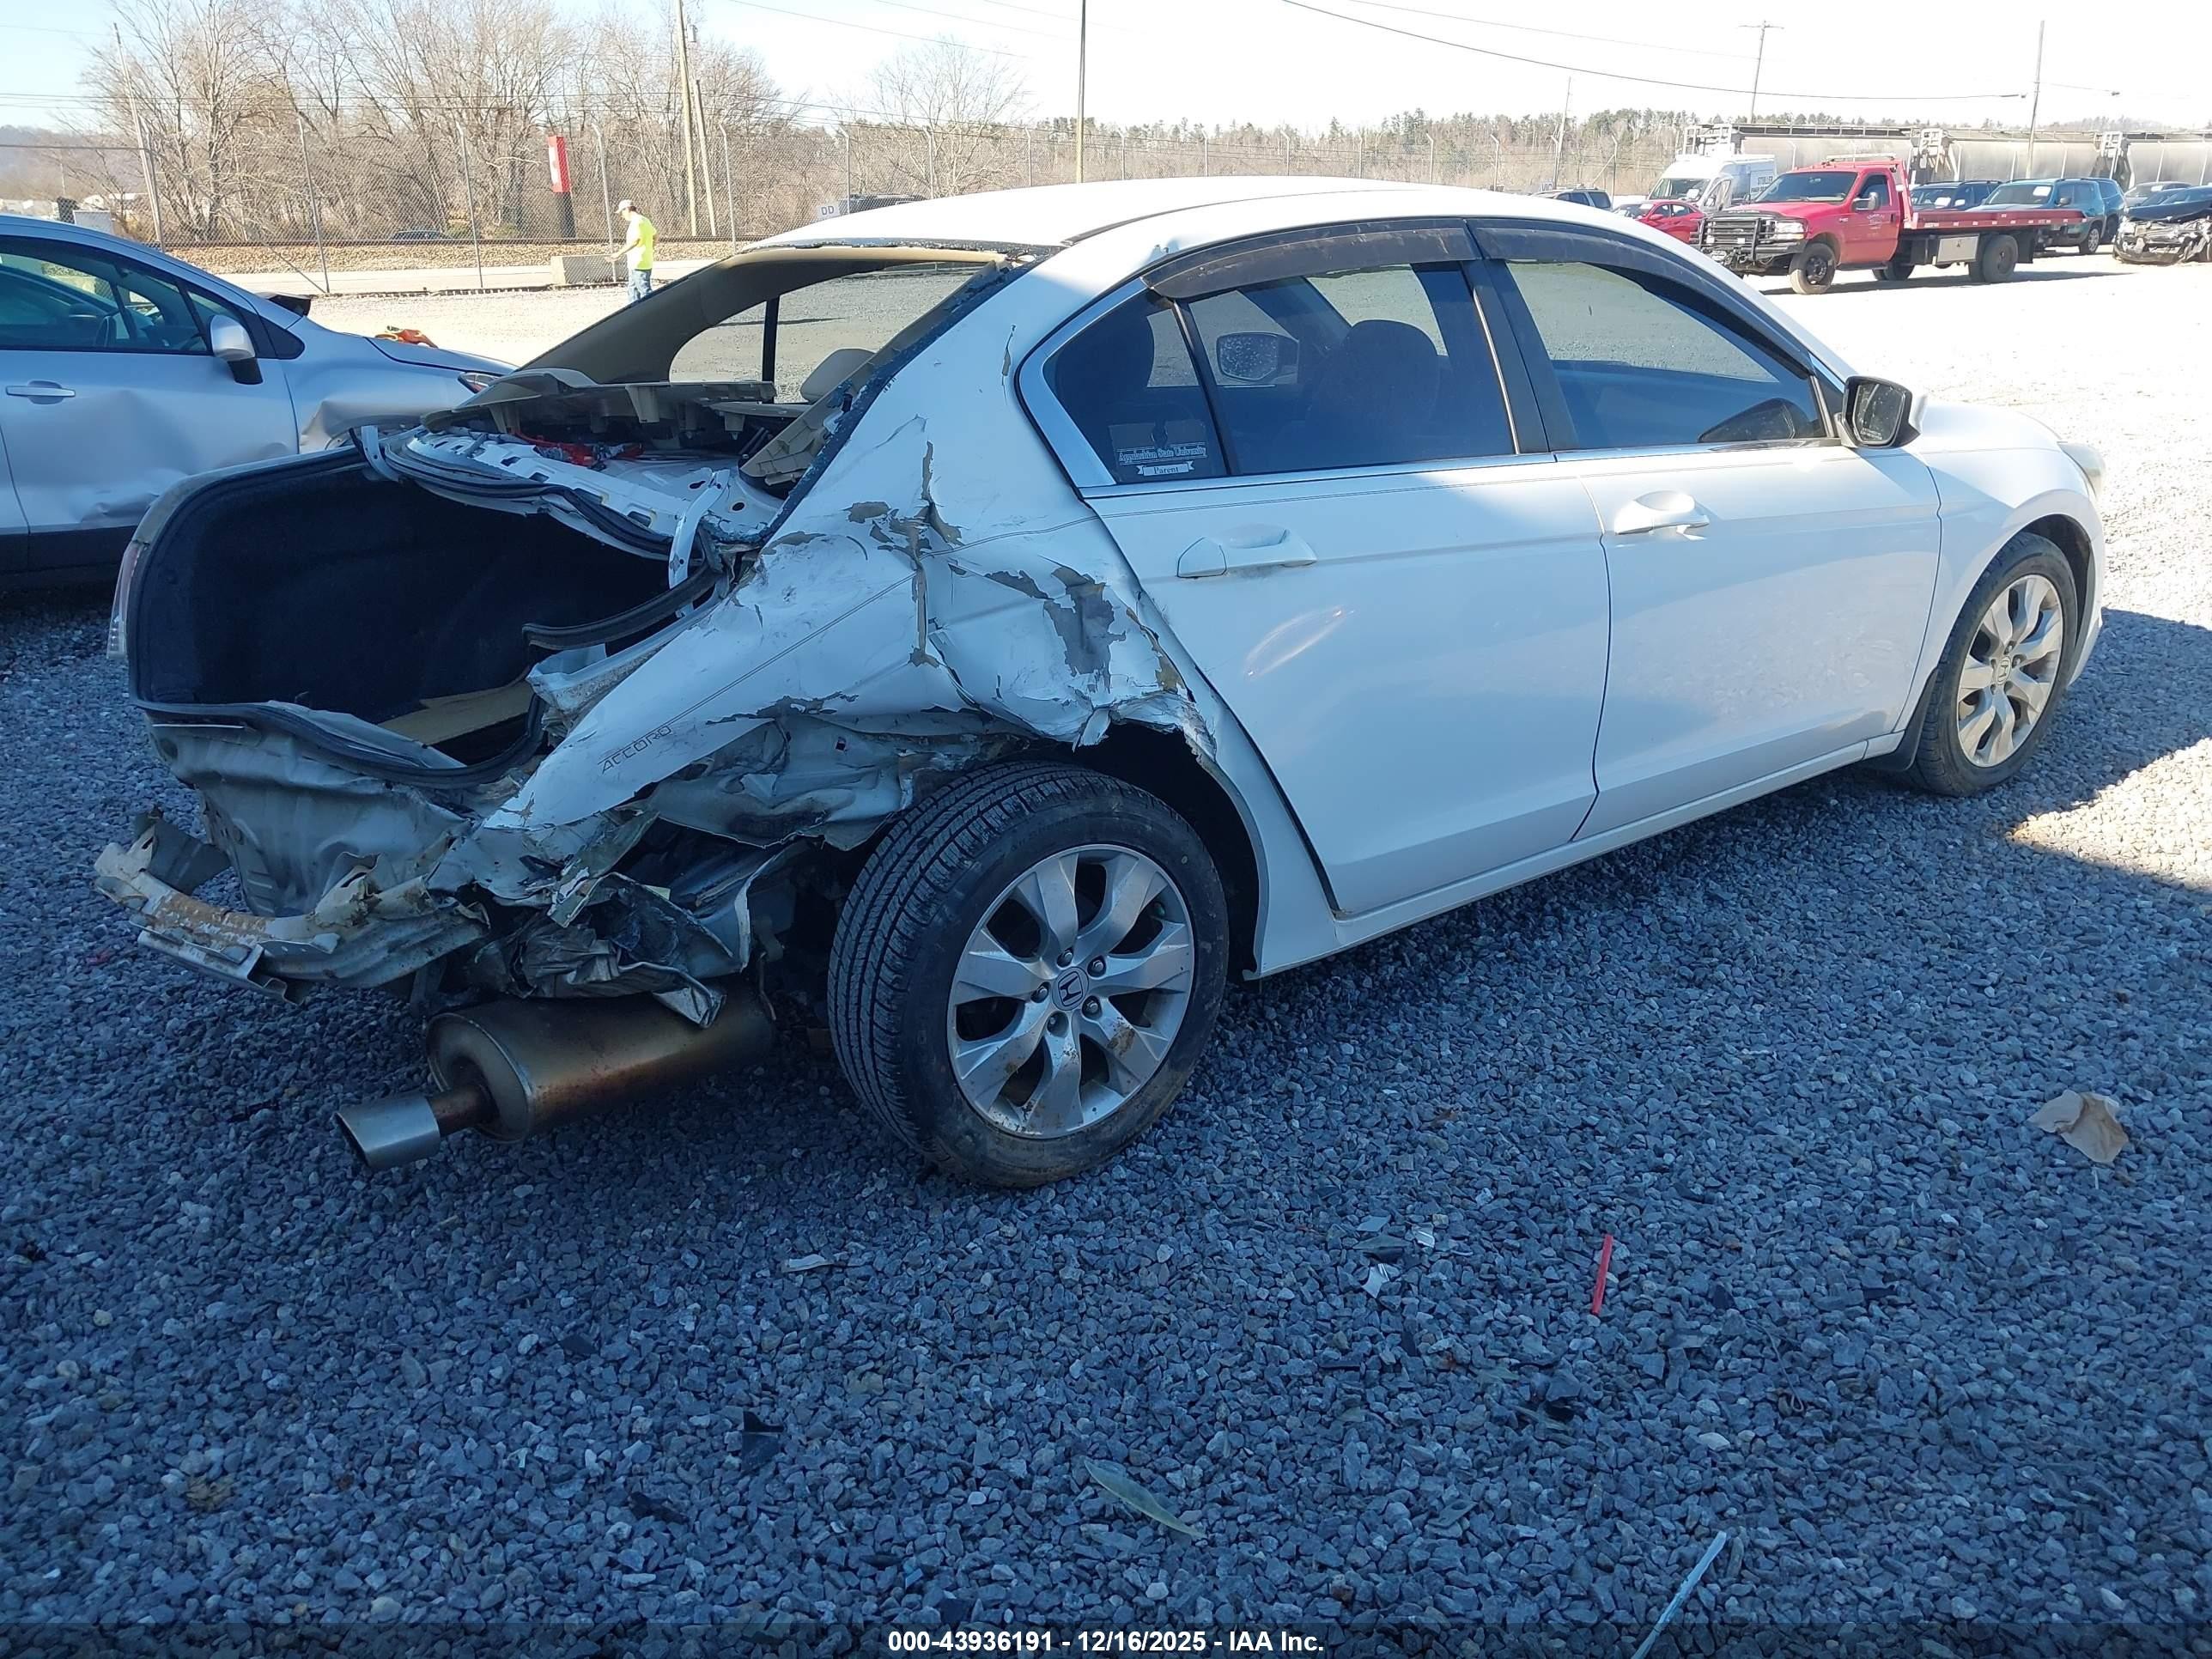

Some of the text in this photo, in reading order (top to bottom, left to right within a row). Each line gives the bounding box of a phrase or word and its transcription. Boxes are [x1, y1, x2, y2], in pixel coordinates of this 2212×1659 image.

[1119, 445, 1206, 463] Appalachian State University
[1153, 465, 1179, 475] Parent
[601, 725, 672, 775] ACCORD
